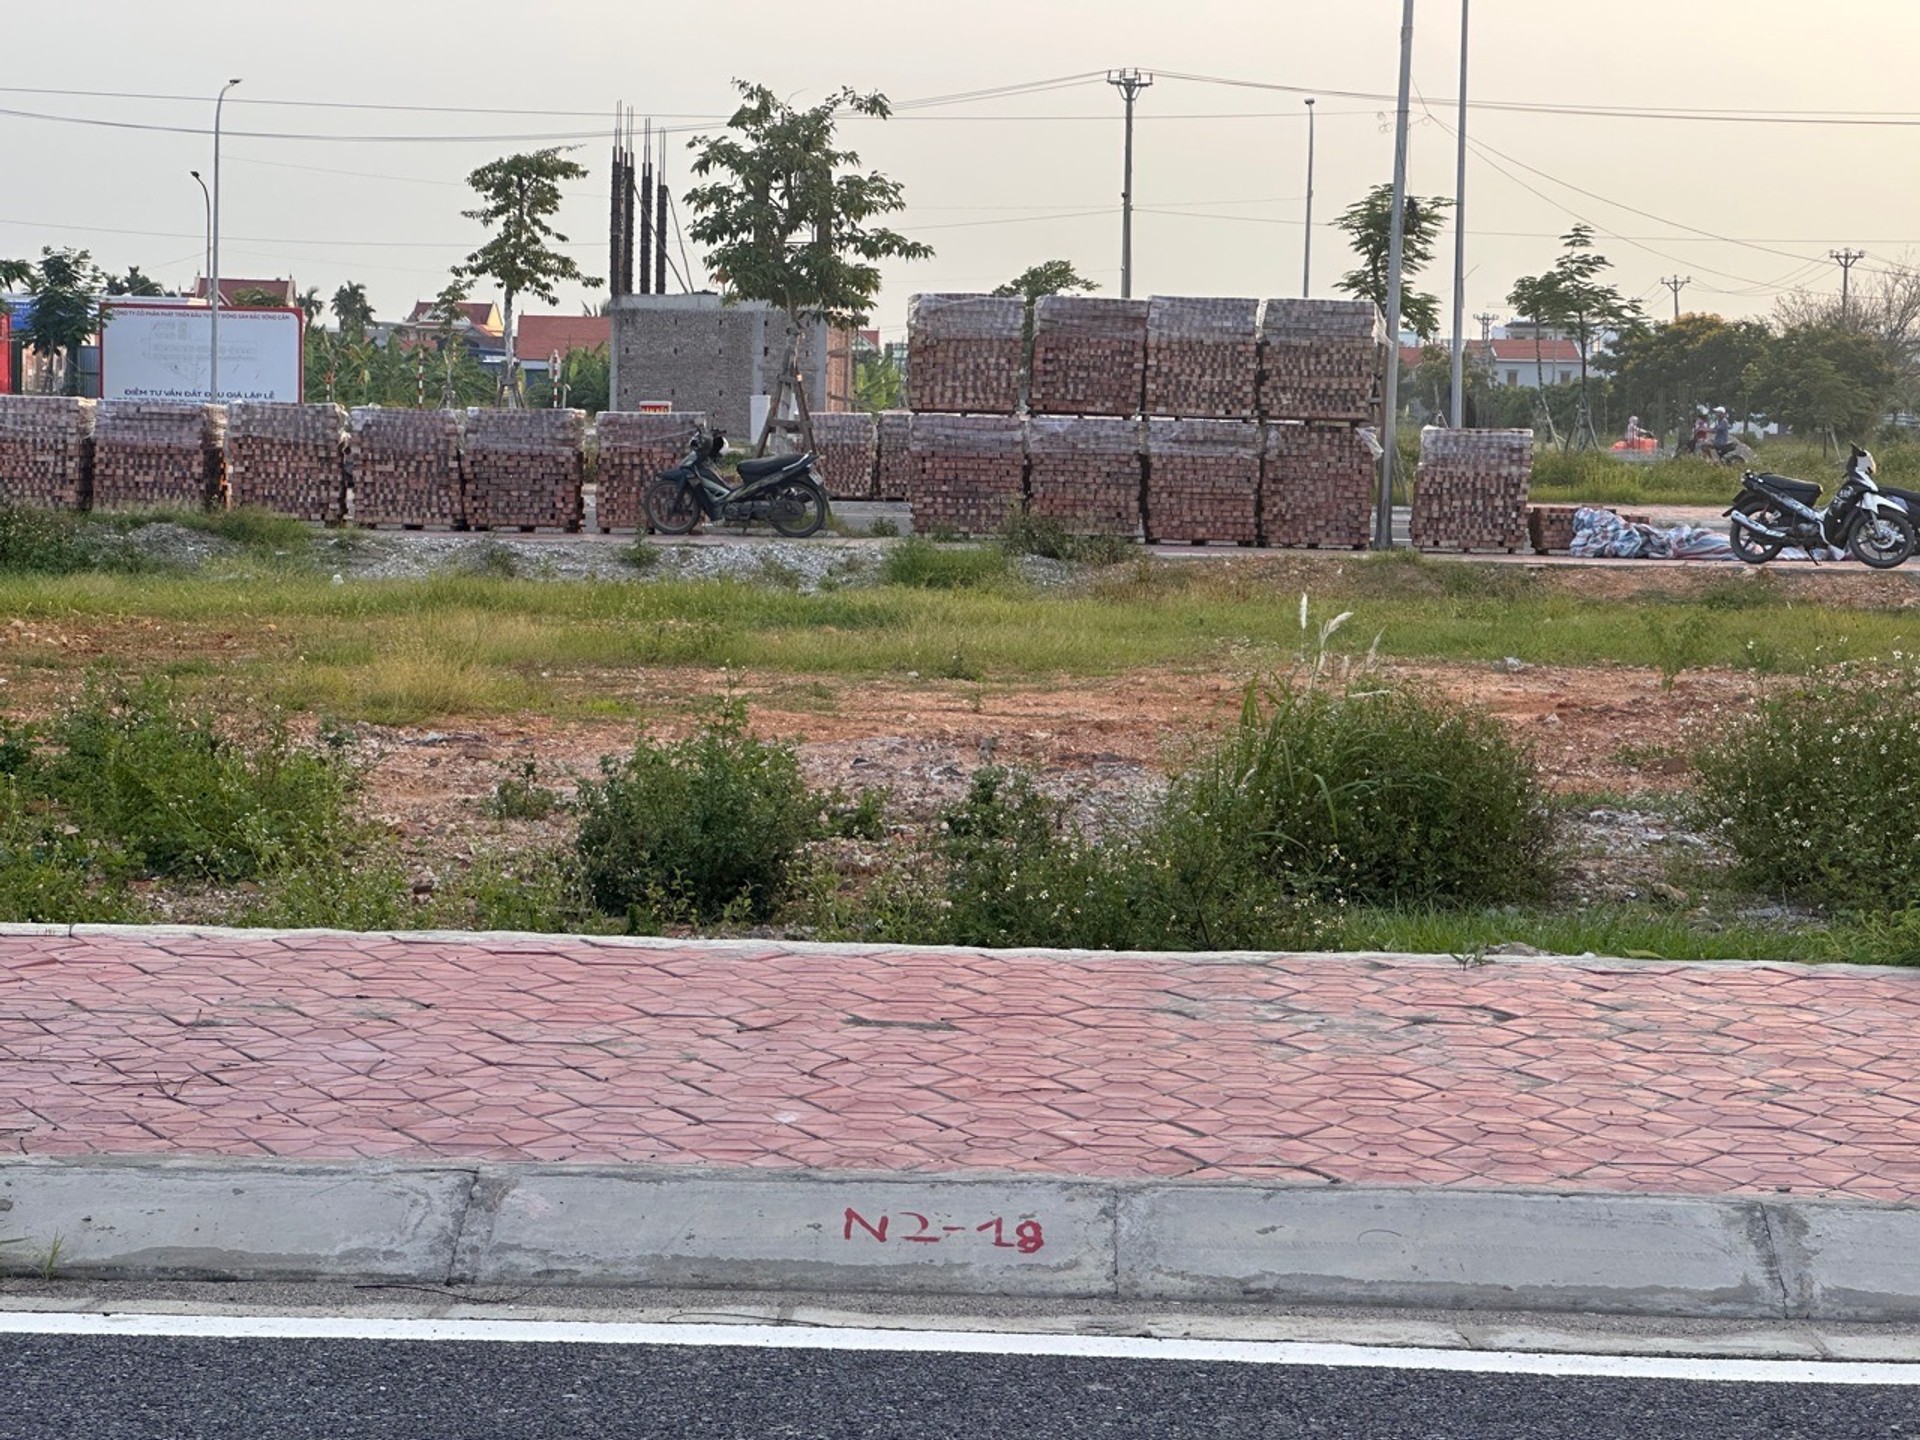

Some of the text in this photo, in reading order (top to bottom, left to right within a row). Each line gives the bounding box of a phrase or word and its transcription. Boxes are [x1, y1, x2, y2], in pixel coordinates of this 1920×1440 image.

[124, 387, 147, 396] ĐIỂM
[149, 388, 162, 396] TƯ
[226, 390, 243, 399] GIÁ
[844, 1207, 1044, 1254] N2-18
